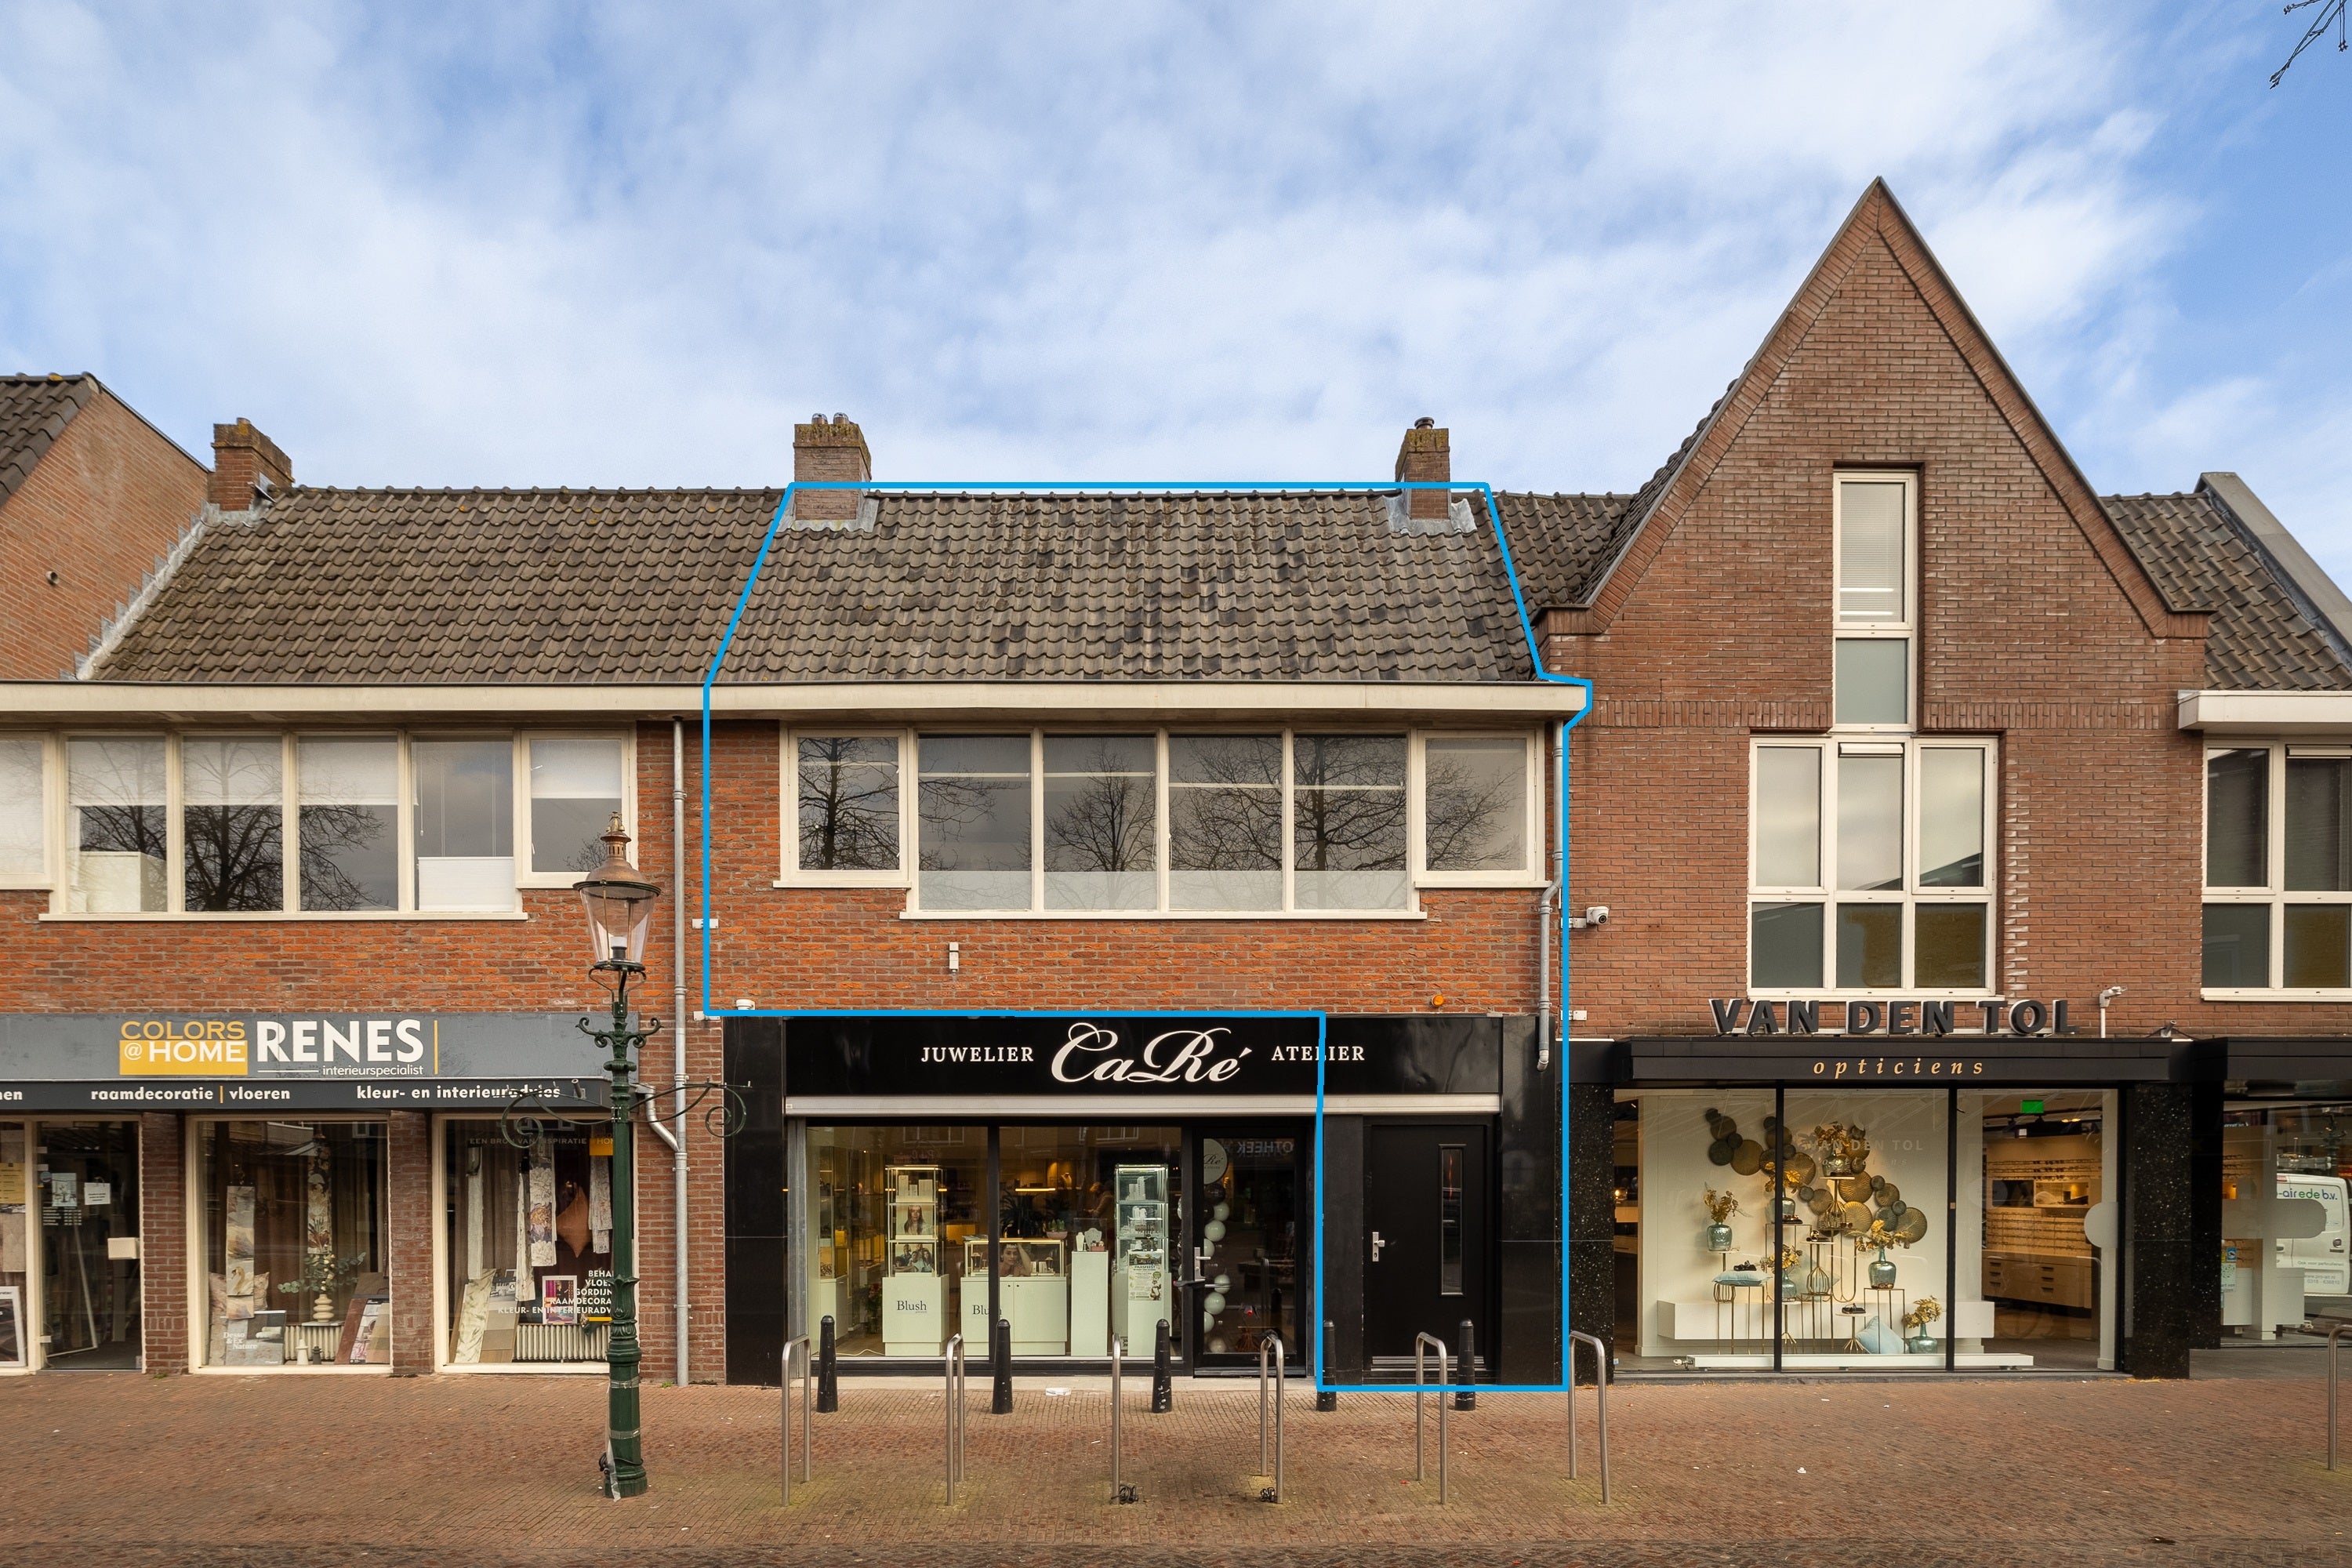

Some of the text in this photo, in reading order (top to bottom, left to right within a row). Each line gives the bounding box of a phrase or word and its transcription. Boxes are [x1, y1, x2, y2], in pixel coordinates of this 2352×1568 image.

[1708, 999, 2081, 1036] VAN DEN TOL
[121, 1021, 245, 1040] COLORS
[256, 1018, 425, 1063] RENES
[920, 1022, 1366, 1083] JUWELIER CaRé ATELIER
[322, 1064, 423, 1078] interieurspecialist
[1813, 1058, 1984, 1079] opticiens
[91, 1086, 290, 1100] raamdecoratie vloeren
[357, 1085, 405, 1098] kleur-
[411, 1087, 430, 1098] en
[1809, 1140, 1923, 1151] VAN DEN TOL
[1203, 1153, 1224, 1165] Ré
[2277, 1188, 2338, 1200] -air ede b.v.
[588, 1269, 614, 1278] BEHA
[897, 1300, 927, 1311] Blush
[972, 1305, 1002, 1315] Blu
